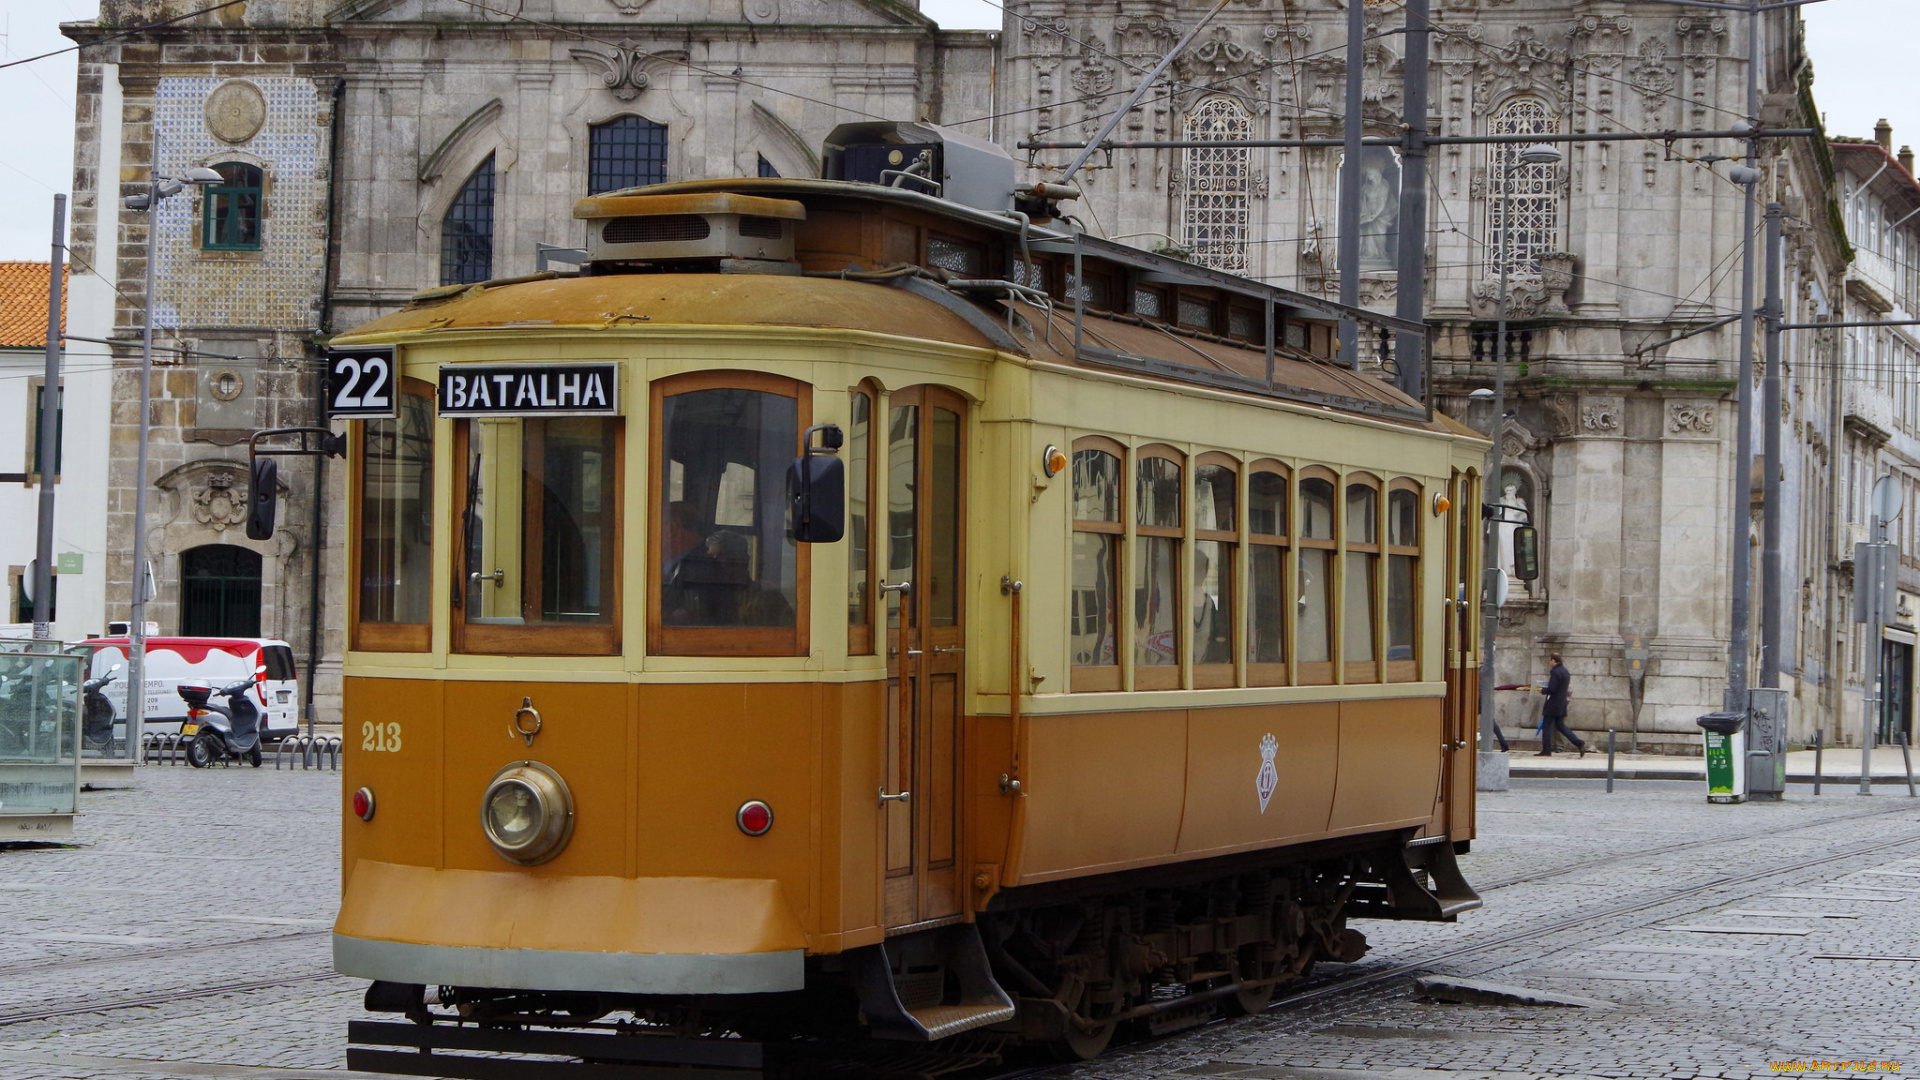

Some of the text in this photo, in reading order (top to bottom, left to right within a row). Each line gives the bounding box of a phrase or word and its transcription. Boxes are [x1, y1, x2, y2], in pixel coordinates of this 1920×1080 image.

[334, 357, 389, 408] 22
[446, 372, 607, 408] BATALHA
[144, 680, 165, 689] EMPO.
[361, 720, 402, 753] 213
